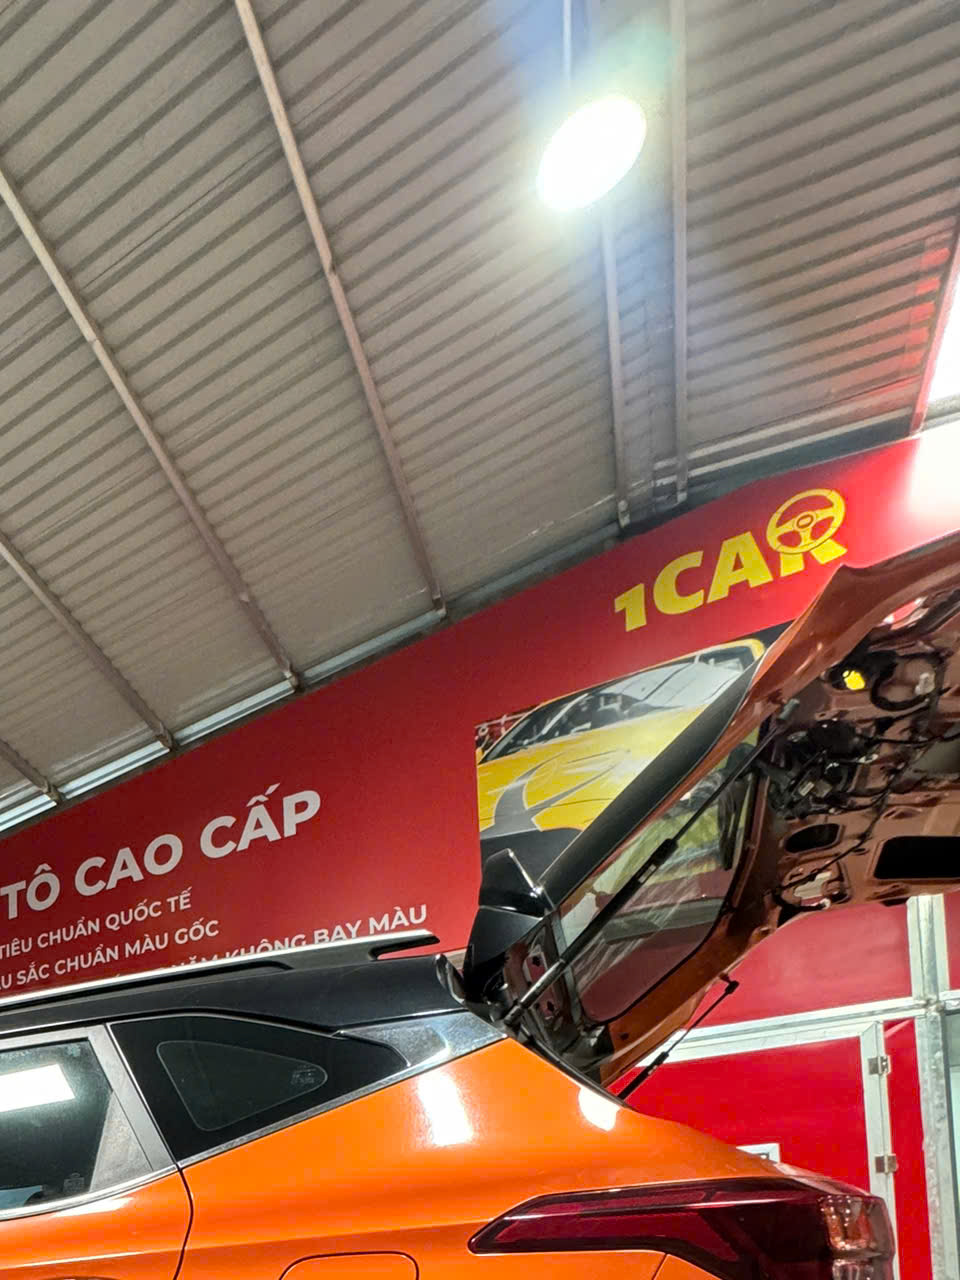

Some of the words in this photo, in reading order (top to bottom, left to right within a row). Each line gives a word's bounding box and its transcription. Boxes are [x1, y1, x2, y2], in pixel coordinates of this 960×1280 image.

[615, 489, 848, 632] 1CAR
[0, 863, 61, 920] TÔ
[74, 833, 184, 899] CAO
[200, 782, 322, 859] CẤP
[16, 960, 50, 985] SẮC
[54, 944, 119, 976] CHUẨN
[124, 933, 169, 958] MÀU
[174, 917, 220, 945] GỐC
[37, 916, 100, 949] CHUẨN
[105, 898, 162, 931] QUỐC
[167, 886, 193, 913] TẾ
[314, 920, 362, 944] BAY
[368, 904, 428, 935] MÀU
